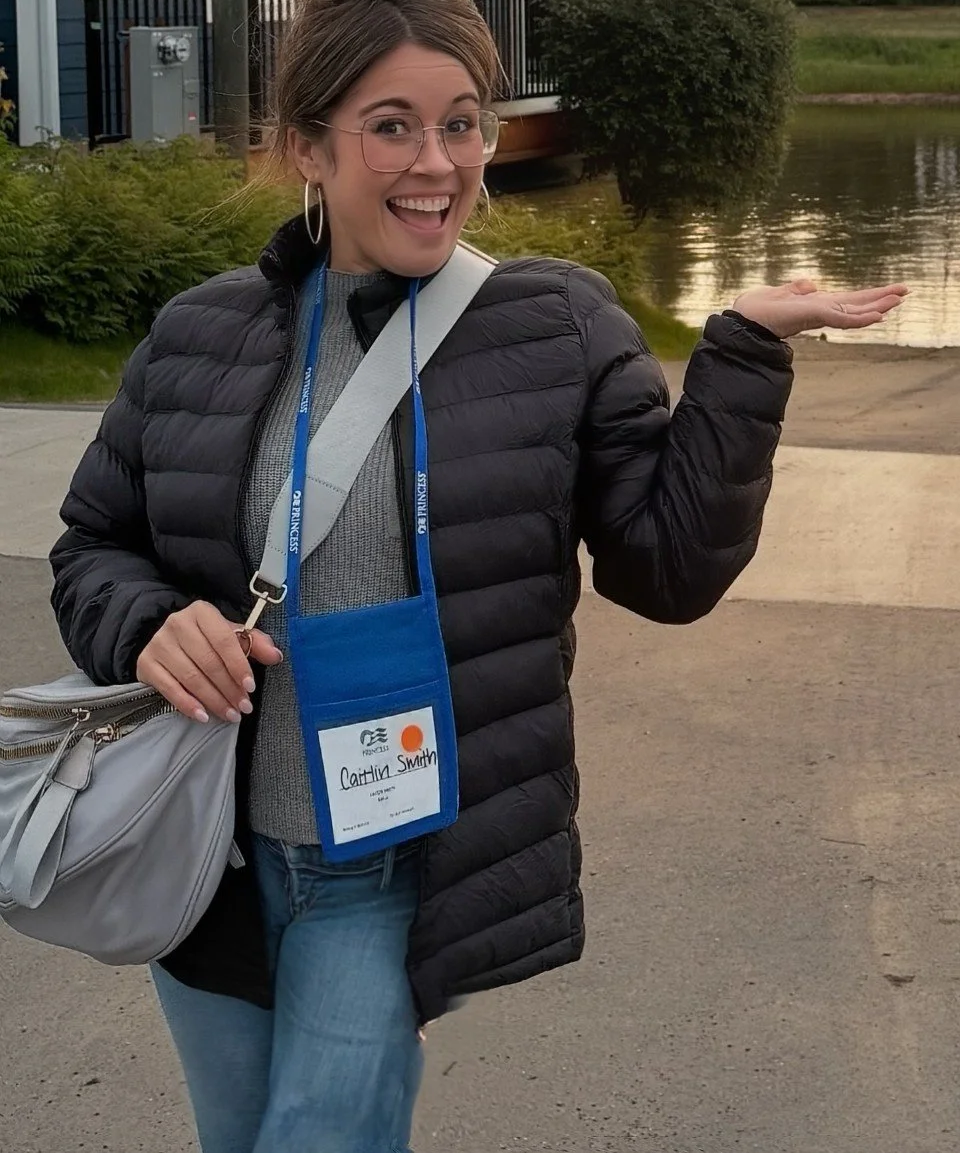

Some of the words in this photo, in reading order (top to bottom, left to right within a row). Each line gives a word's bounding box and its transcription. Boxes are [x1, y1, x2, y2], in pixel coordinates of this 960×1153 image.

[417, 471, 427, 517] PRINCESS
[289, 507, 301, 554] PRINCESS
[340, 764, 390, 791] Caitlin
[397, 748, 437, 773] Smith
